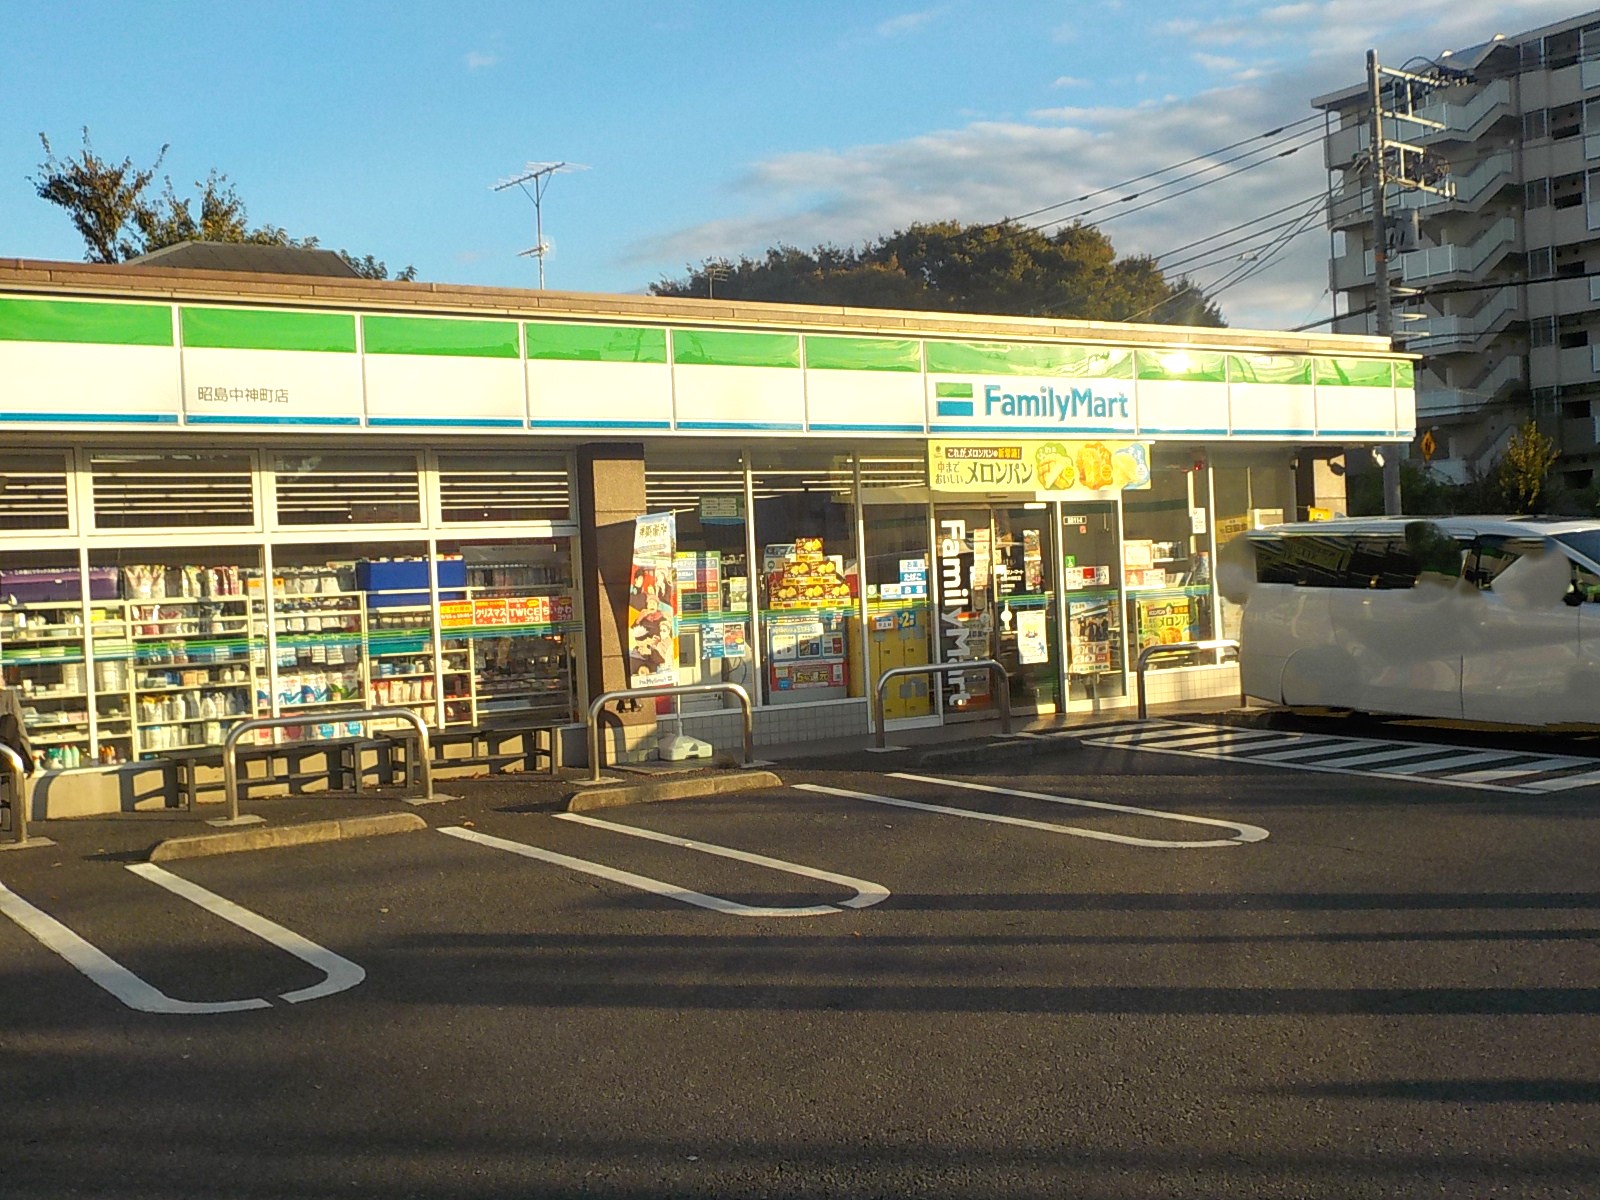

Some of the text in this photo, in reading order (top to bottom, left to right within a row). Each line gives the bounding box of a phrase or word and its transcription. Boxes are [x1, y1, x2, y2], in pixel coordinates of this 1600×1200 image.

[198, 386, 288, 403] 昭島中神町店
[984, 385, 1128, 421] FamilyMart
[938, 461, 960, 473] 中まで
[936, 473, 963, 484] おいしい
[965, 461, 1033, 485] メロンパン
[904, 572, 923, 581] たばこ
[476, 607, 506, 618] クリスマス
[509, 608, 540, 617] TWICE
